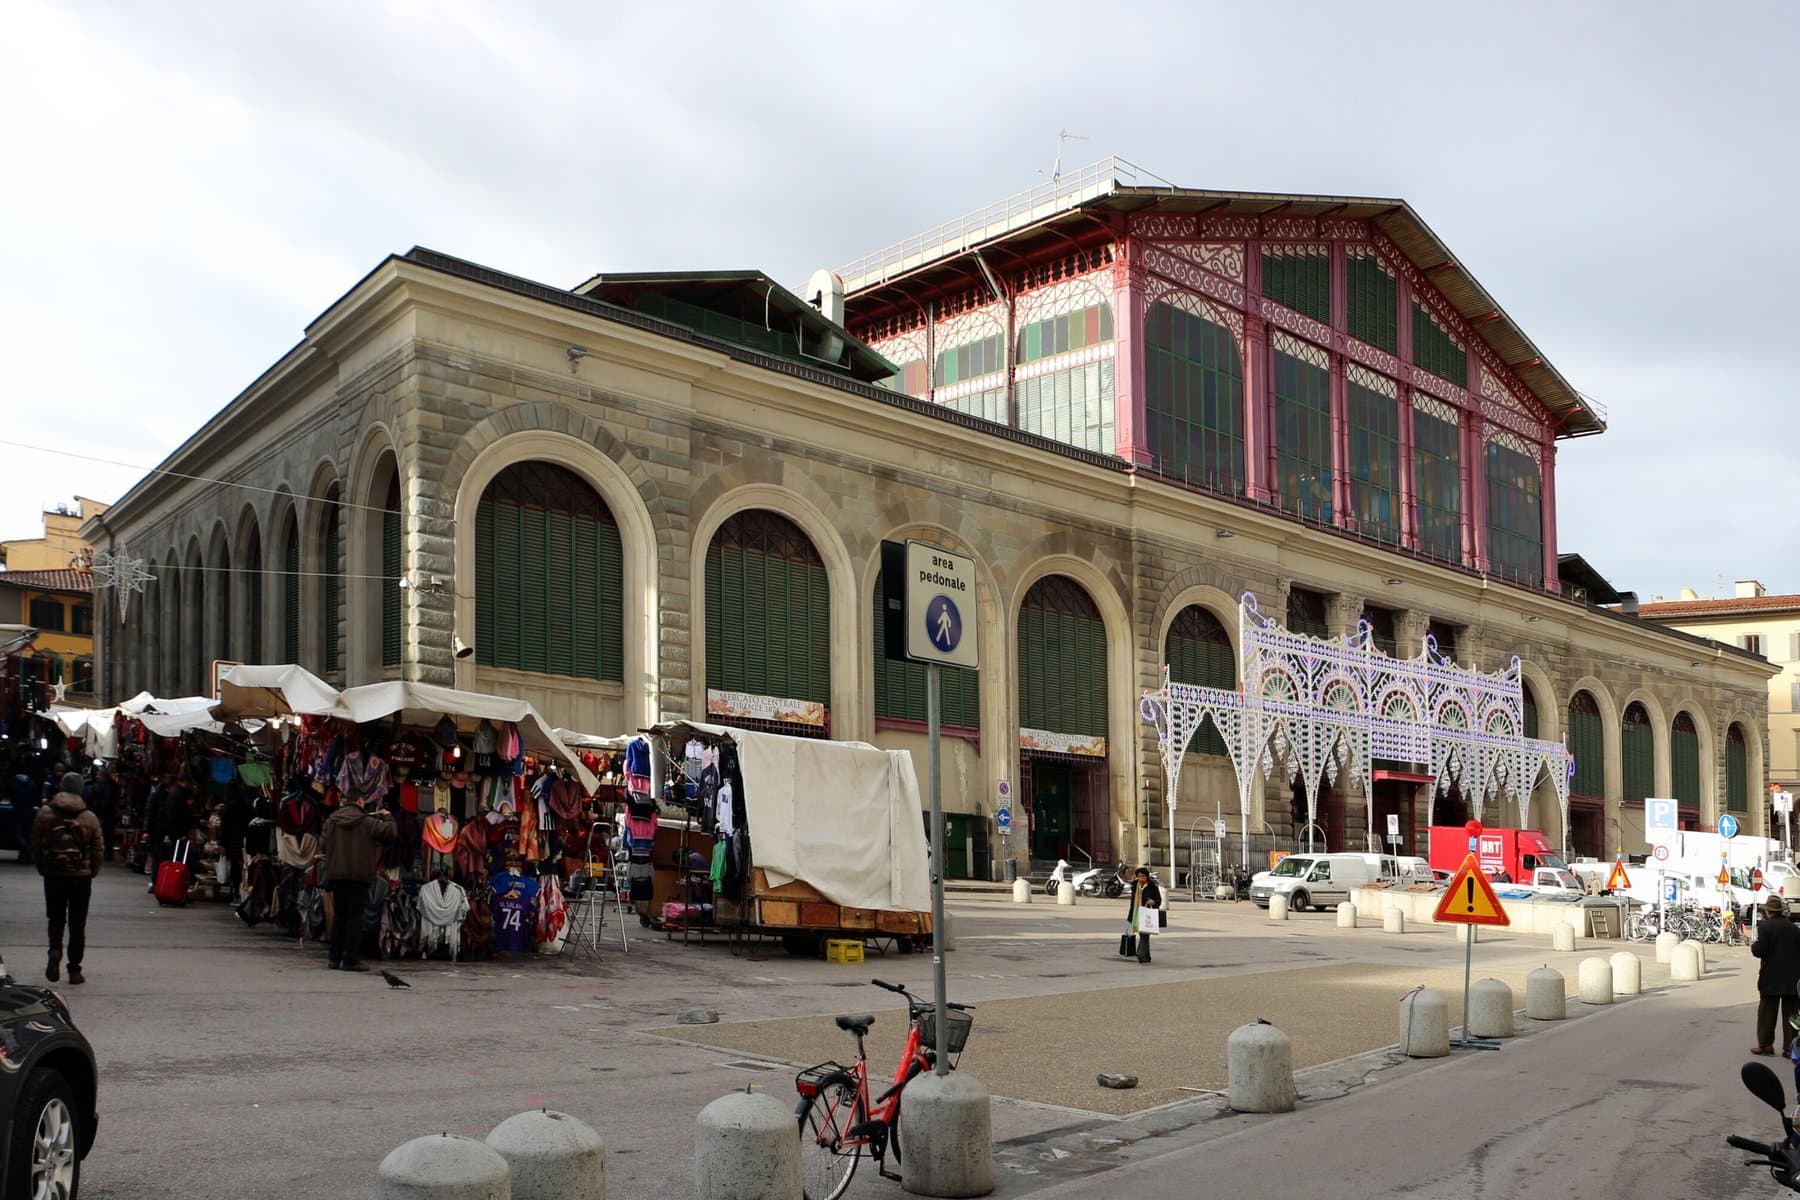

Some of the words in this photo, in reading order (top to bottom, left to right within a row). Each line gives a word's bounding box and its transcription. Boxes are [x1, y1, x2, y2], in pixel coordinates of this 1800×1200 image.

[931, 555, 954, 570] area
[919, 570, 966, 591] pedonale
[719, 692, 760, 704] MERCATO
[761, 697, 801, 709] CENTRALE
[1655, 802, 1669, 822] P
[1481, 841, 1500, 854] BRT
[1665, 886, 1675, 899] P
[502, 908, 521, 932] 74
